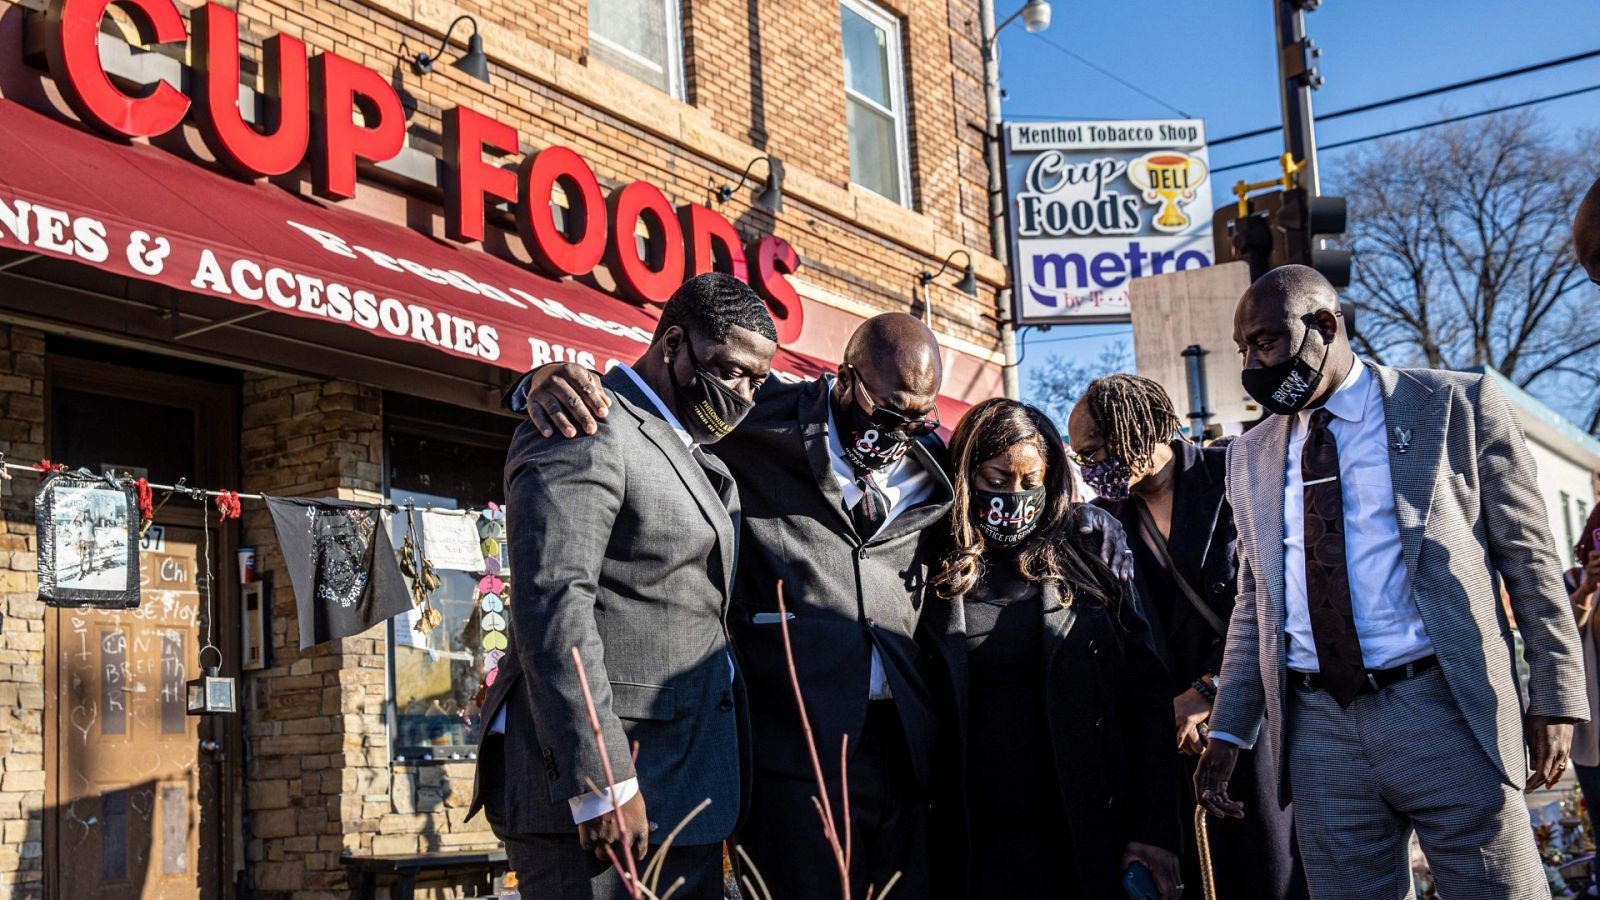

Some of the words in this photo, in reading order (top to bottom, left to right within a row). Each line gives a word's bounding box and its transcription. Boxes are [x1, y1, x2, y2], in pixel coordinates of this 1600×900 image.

[1018, 126, 1083, 143] Menthol
[1088, 125, 1153, 142] Tobacco
[1159, 124, 1197, 142] Shop
[48, 0, 406, 199] CUP
[446, 105, 803, 344] FOODS
[1029, 152, 1124, 200] Cup
[1149, 168, 1188, 190] DELI
[1020, 194, 1140, 232] Foods
[126, 230, 171, 276] &
[190, 248, 501, 362] ACCESSORIES
[1282, 379, 1309, 407] LAW
[987, 495, 1036, 528] 8:46
